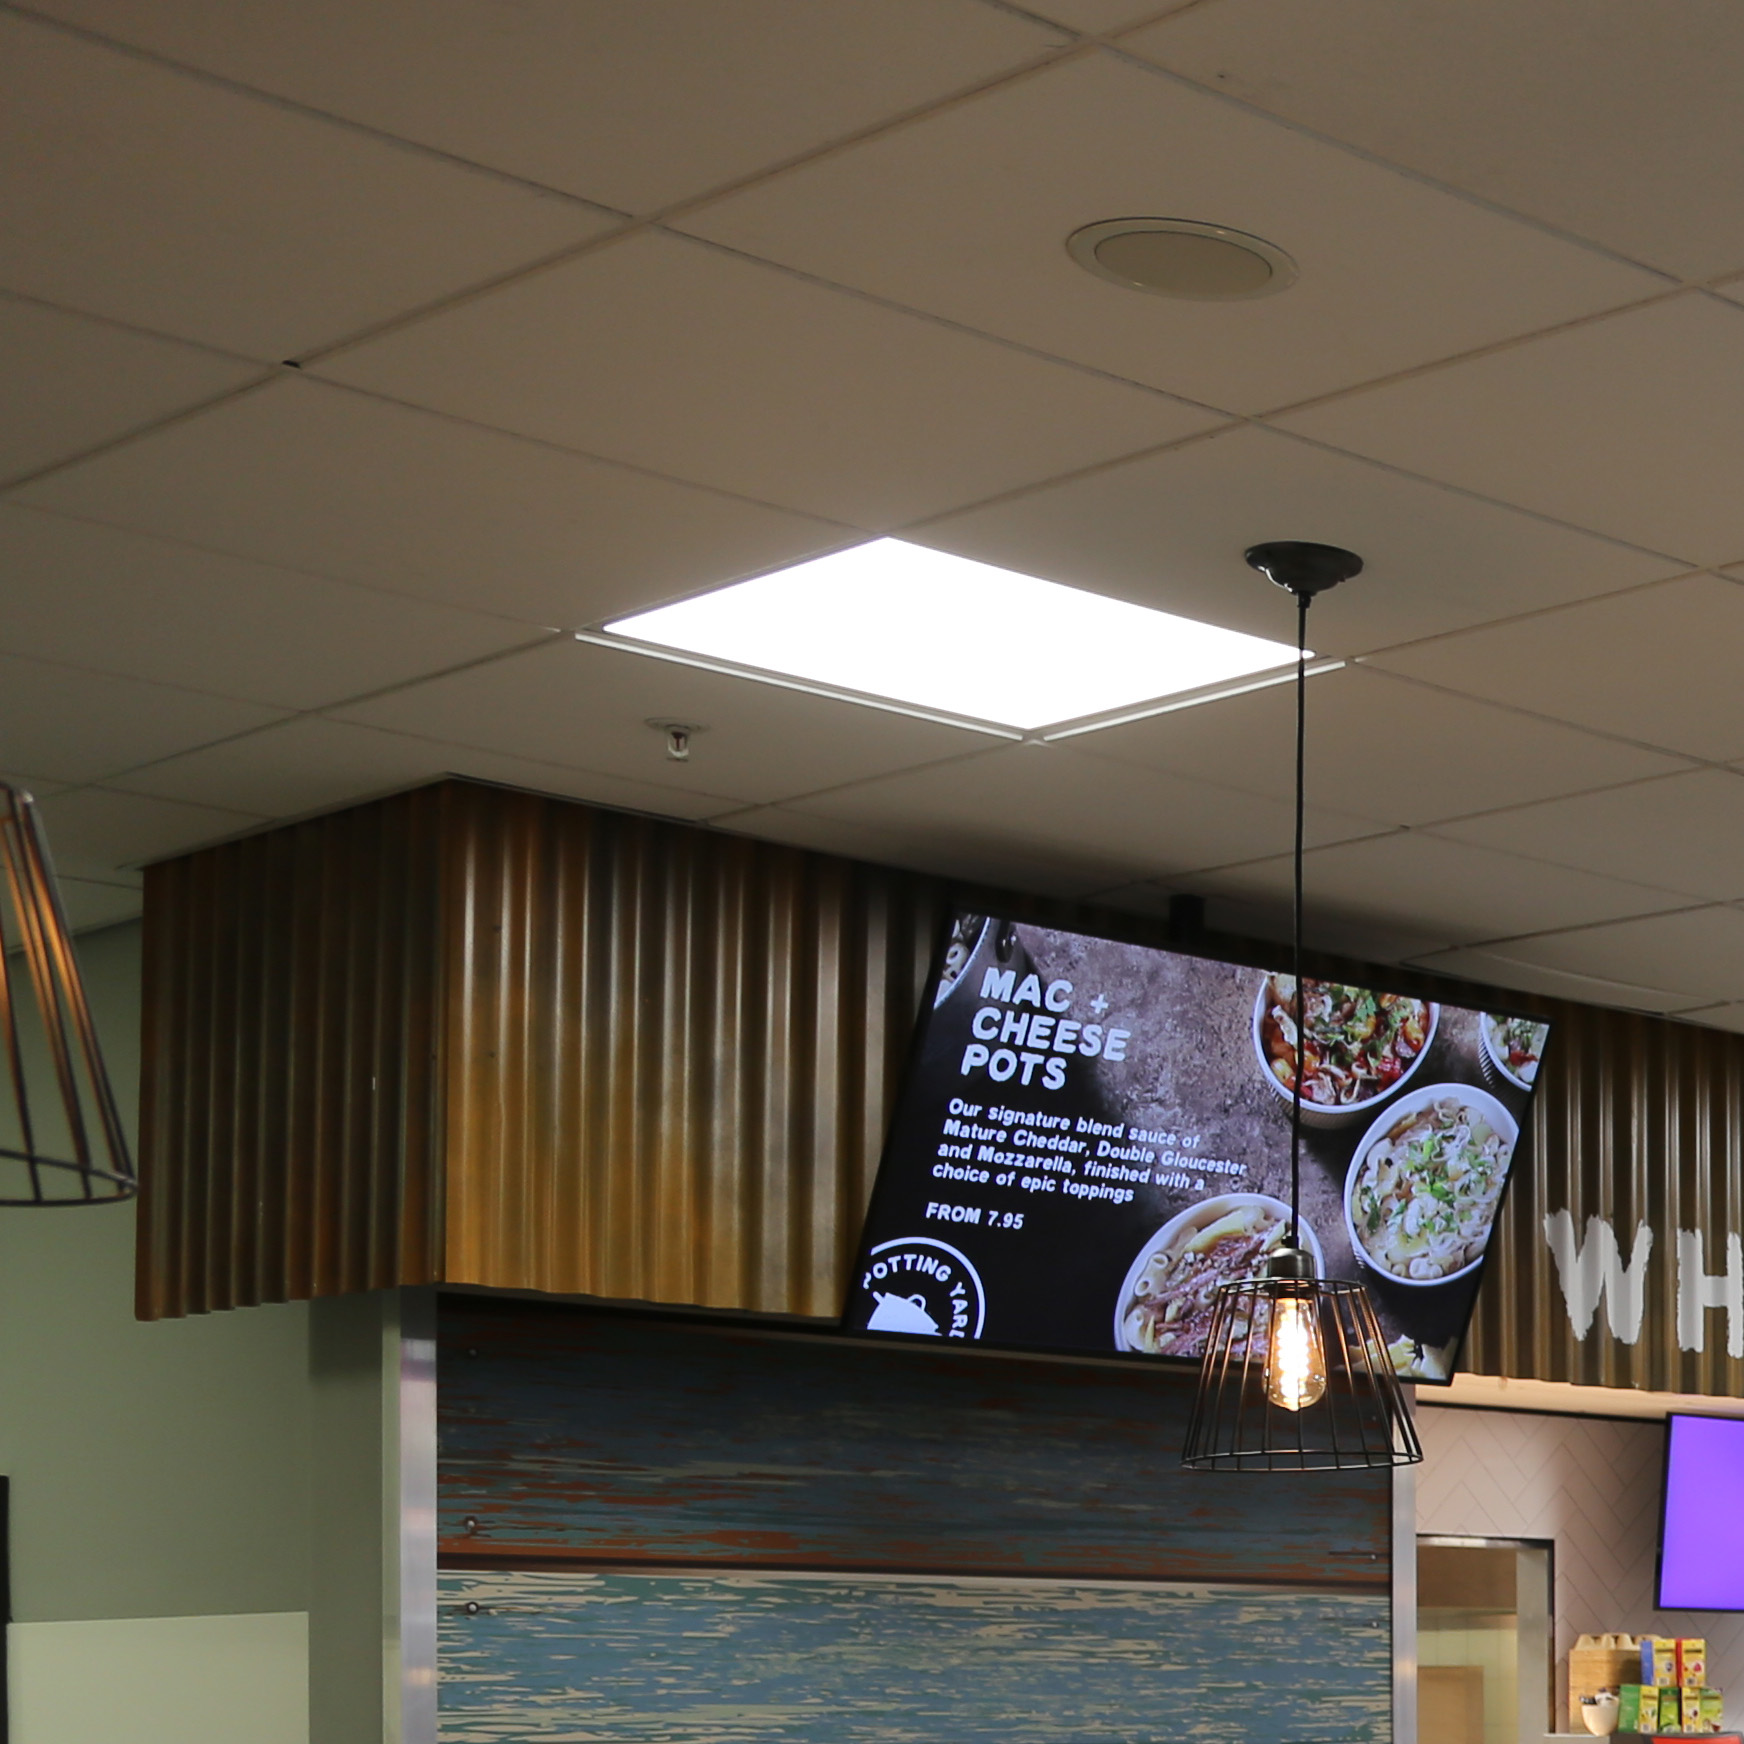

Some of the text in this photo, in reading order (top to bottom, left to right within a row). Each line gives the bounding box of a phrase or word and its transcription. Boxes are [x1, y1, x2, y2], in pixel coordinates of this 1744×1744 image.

[980, 967, 1109, 1014] MAC +
[972, 1006, 1131, 1062] CHEESE
[960, 1044, 1067, 1090] POTS
[943, 1119, 1247, 1176] Mature Cheddar, Double Gloucester
[949, 1098, 1200, 1149] Our signature blend sauce of
[932, 1162, 1134, 1204] choice of epic toppings
[938, 1142, 1205, 1191] and Mozzarella, finished with a
[925, 1201, 1024, 1230] FROM 7.95
